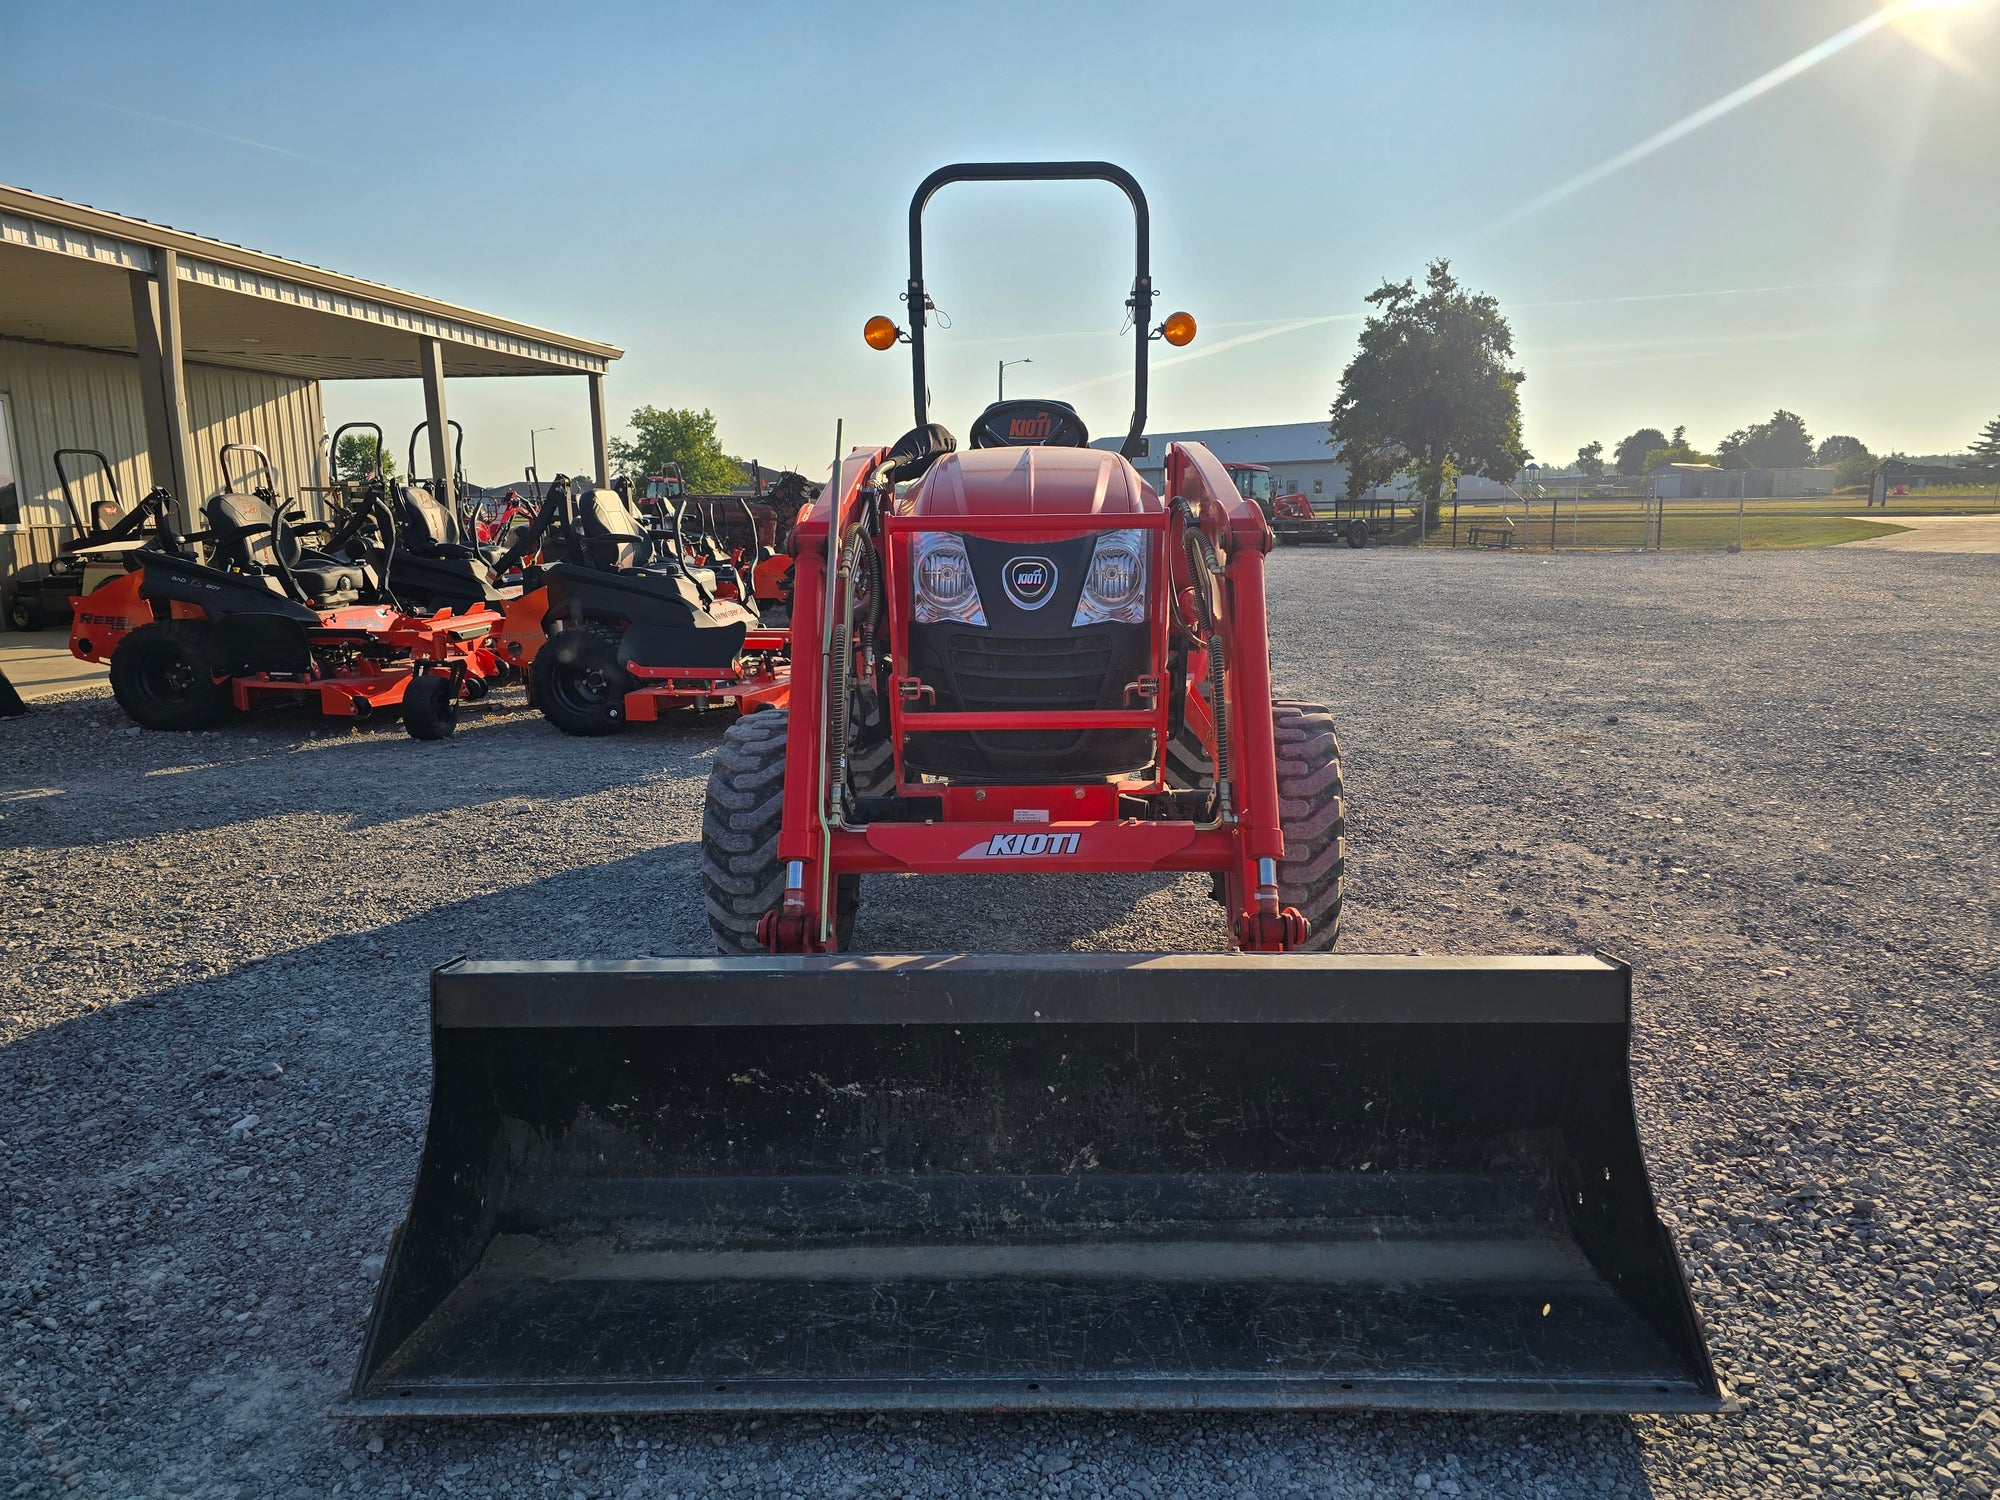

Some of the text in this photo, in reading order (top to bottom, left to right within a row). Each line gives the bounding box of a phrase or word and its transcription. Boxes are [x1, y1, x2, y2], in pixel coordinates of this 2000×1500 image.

[1009, 418, 1051, 437] KIOTI
[1017, 573, 1042, 584] KIOTI
[986, 832, 1082, 856] KIOTI
